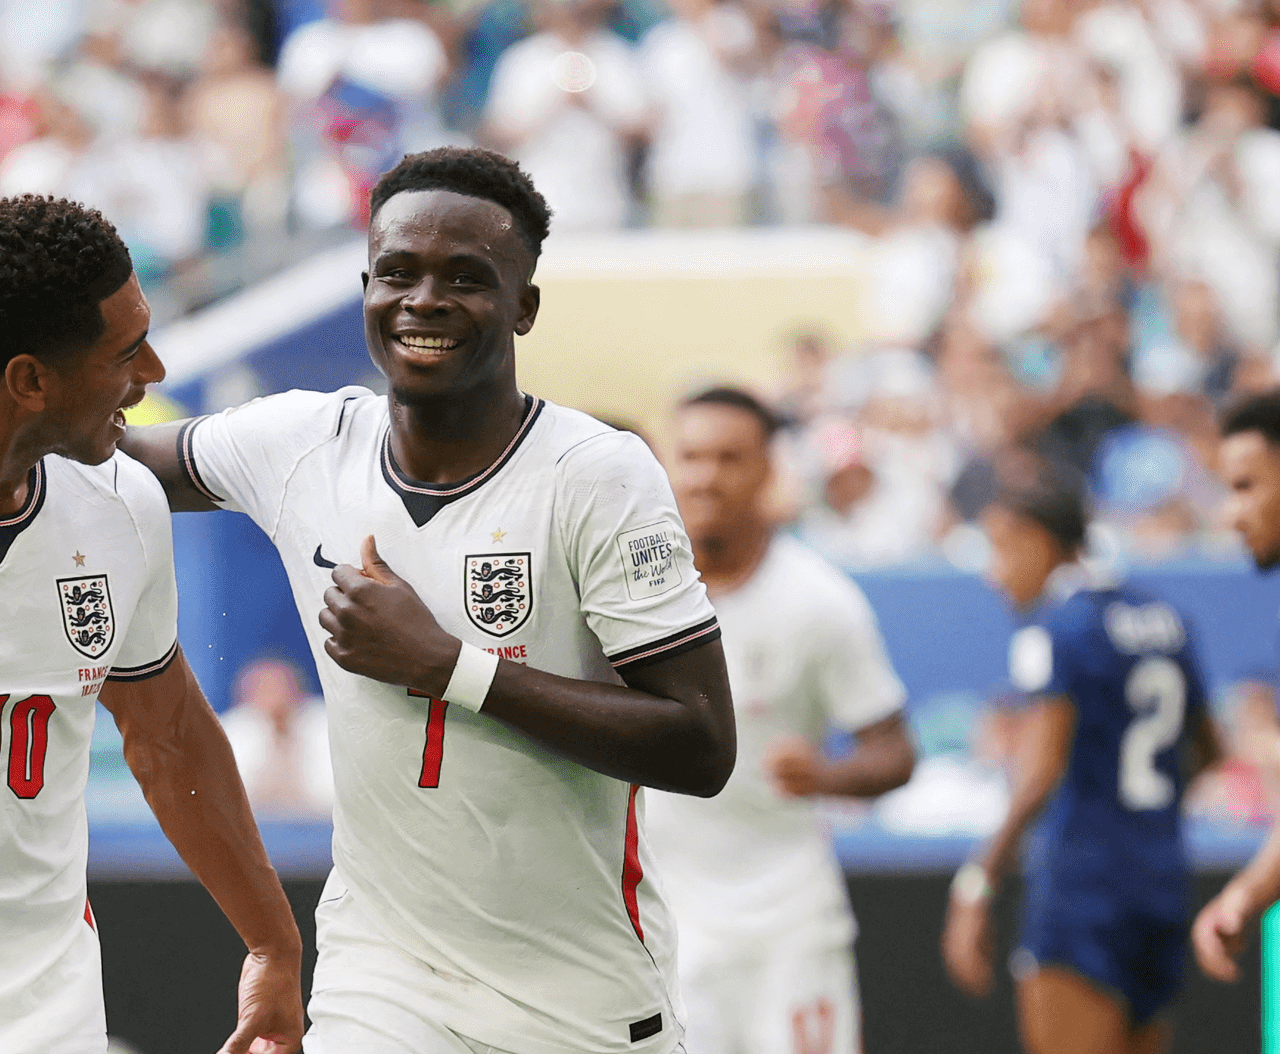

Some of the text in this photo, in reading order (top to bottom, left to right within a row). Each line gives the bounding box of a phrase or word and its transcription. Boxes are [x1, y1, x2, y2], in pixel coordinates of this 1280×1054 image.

[628, 531, 669, 552] FOOTBALL
[631, 543, 672, 567] UNITES
[631, 567, 650, 582] the
[649, 577, 666, 588] FIFA
[482, 645, 527, 660] RANCE
[1119, 655, 1187, 811] 2
